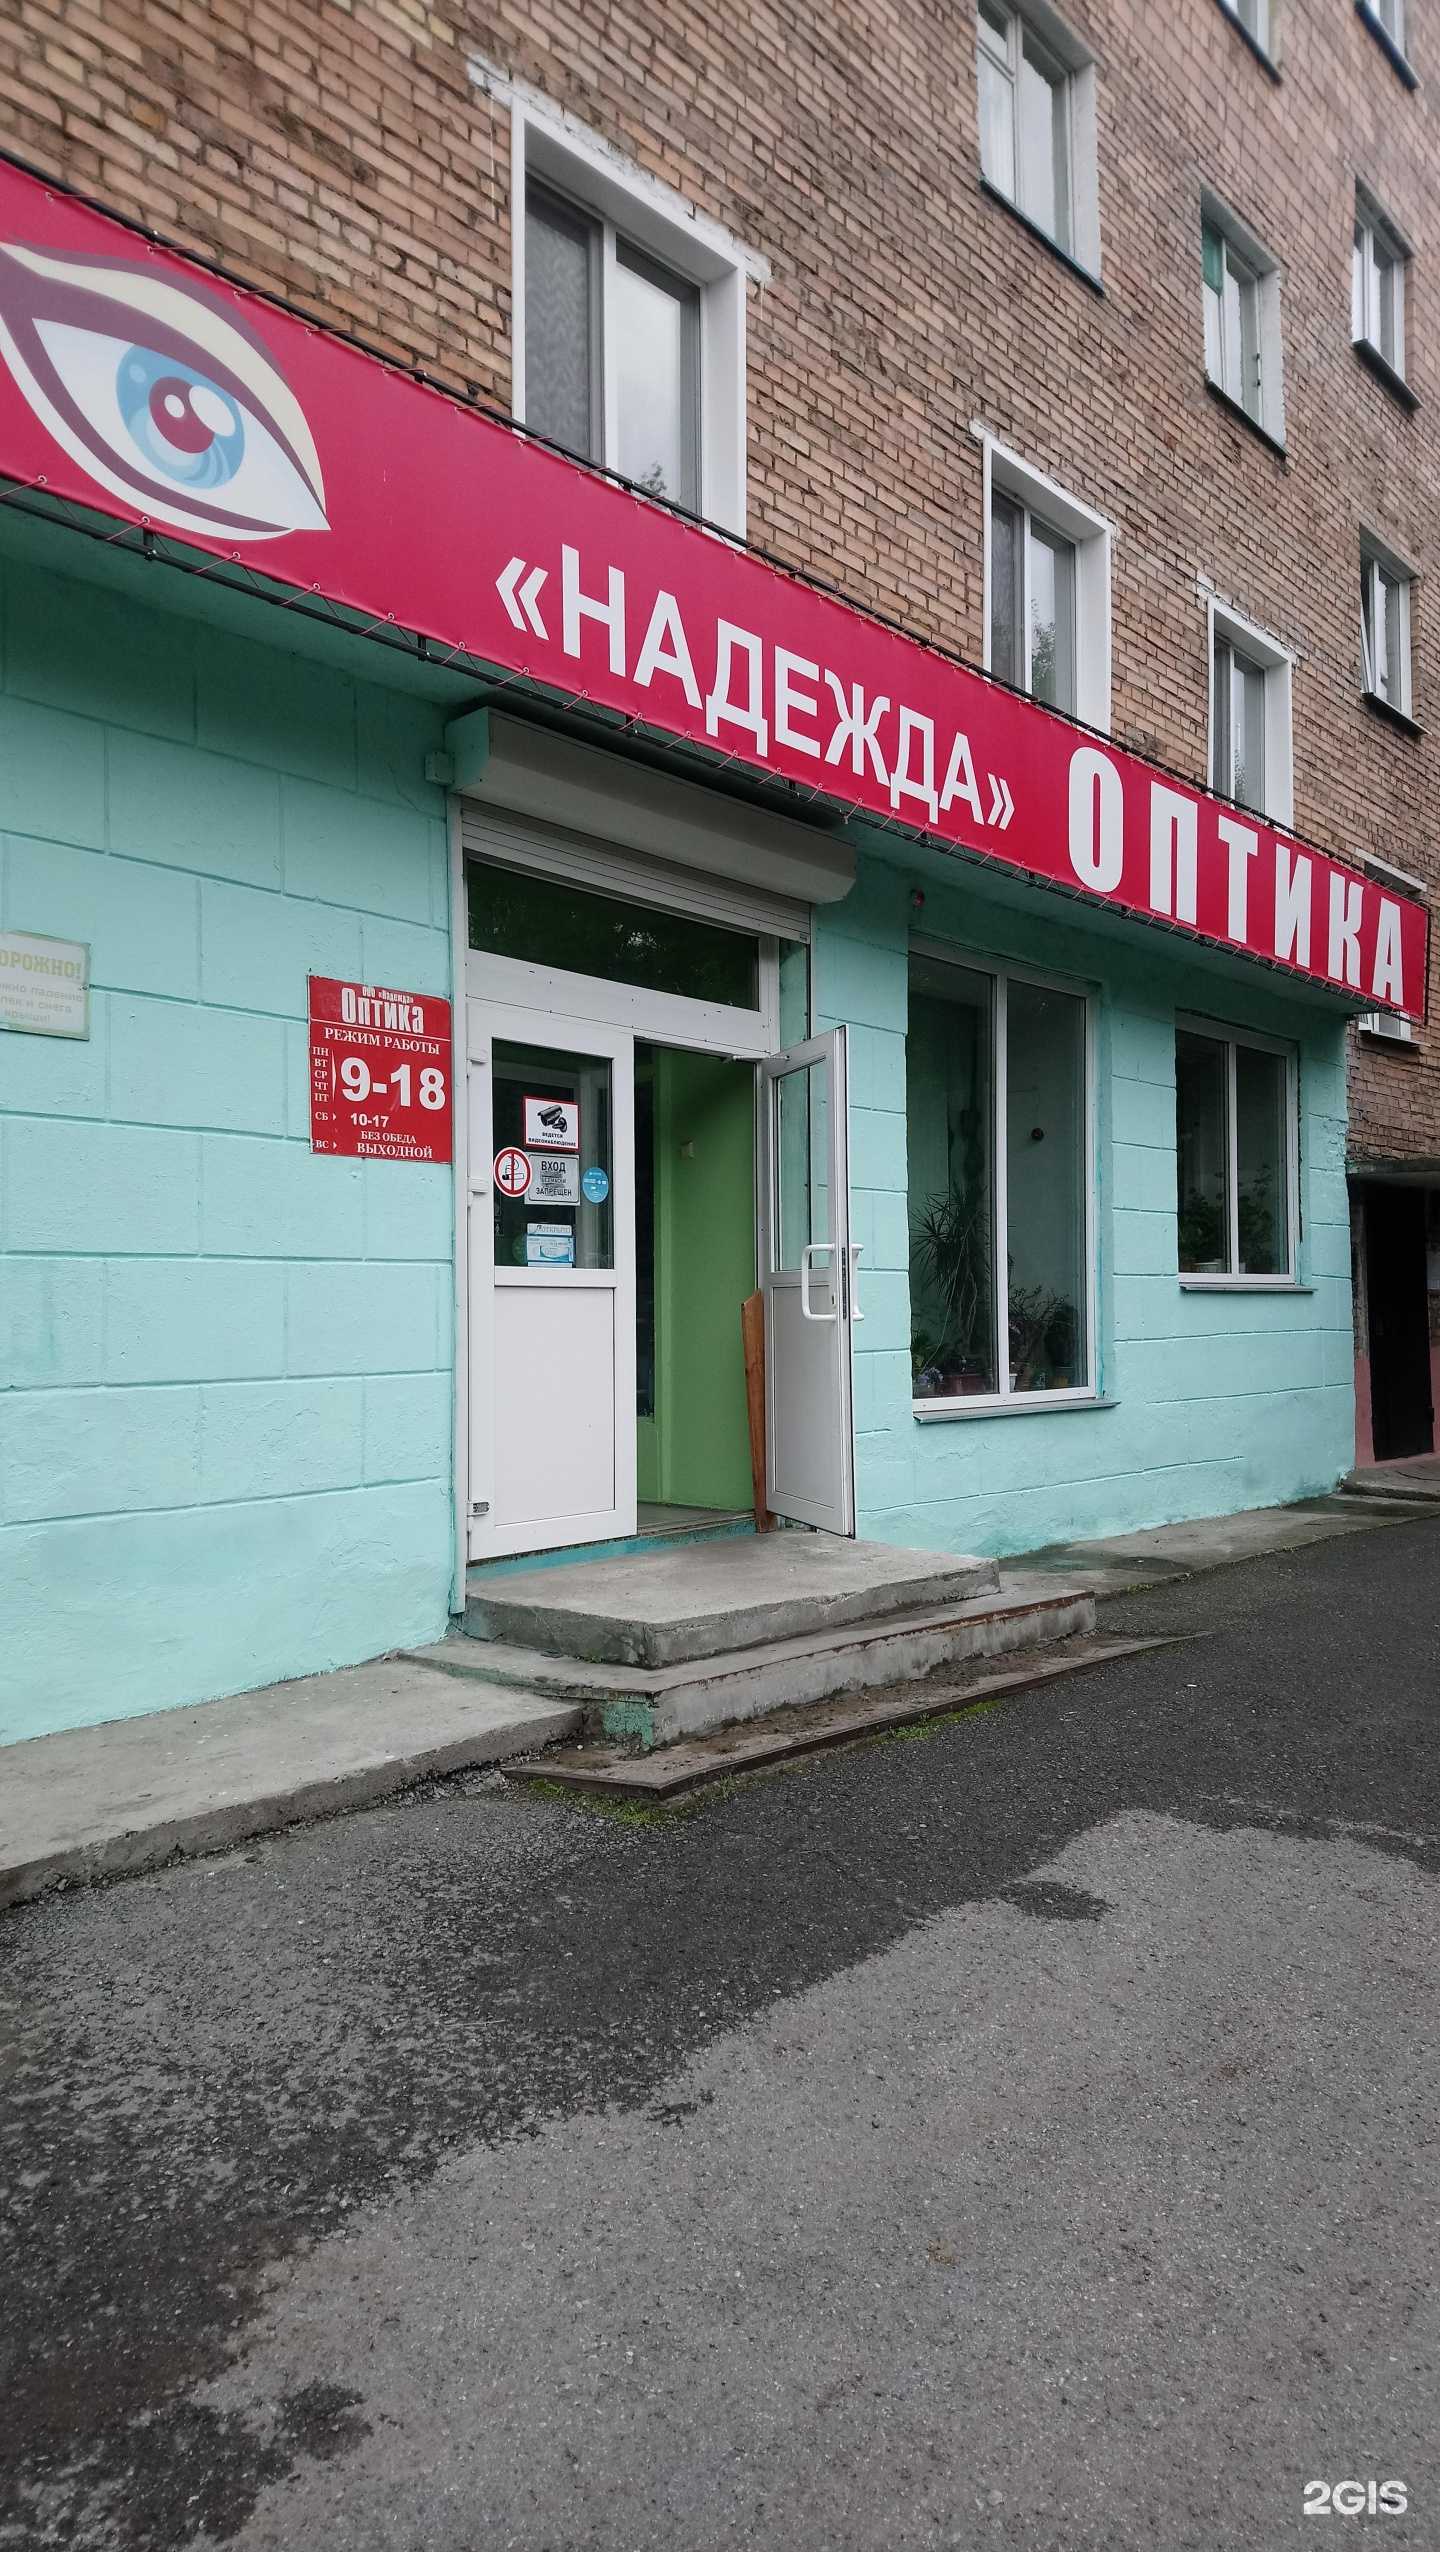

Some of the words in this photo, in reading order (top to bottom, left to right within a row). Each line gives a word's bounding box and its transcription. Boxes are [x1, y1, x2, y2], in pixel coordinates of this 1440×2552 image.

[496, 543, 1015, 831] «НАДЕЖДА»
[1068, 746, 1405, 1006] ОПТИКА
[324, 1027, 380, 1047] РЕЖИМ
[384, 1036, 440, 1055] РАБОТЫ
[312, 1046, 329, 1057] ПН
[314, 1058, 328, 1068] ВТ
[314, 1070, 328, 1079] СР
[314, 1081, 328, 1091] ЧТ
[340, 1057, 446, 1111] 9-18
[314, 1093, 329, 1102] ПТ
[315, 1112, 329, 1121] СБ
[350, 1113, 389, 1128] 10-17
[361, 1130, 380, 1141] БЕЗ
[382, 1132, 417, 1144] ОБЕДА
[315, 1140, 329, 1149] ВС
[357, 1143, 433, 1159] ВЫХОДНОЙ
[541, 1160, 566, 1174] ВХОД
[535, 1187, 572, 1197] ЗАПРЕЩЕН
